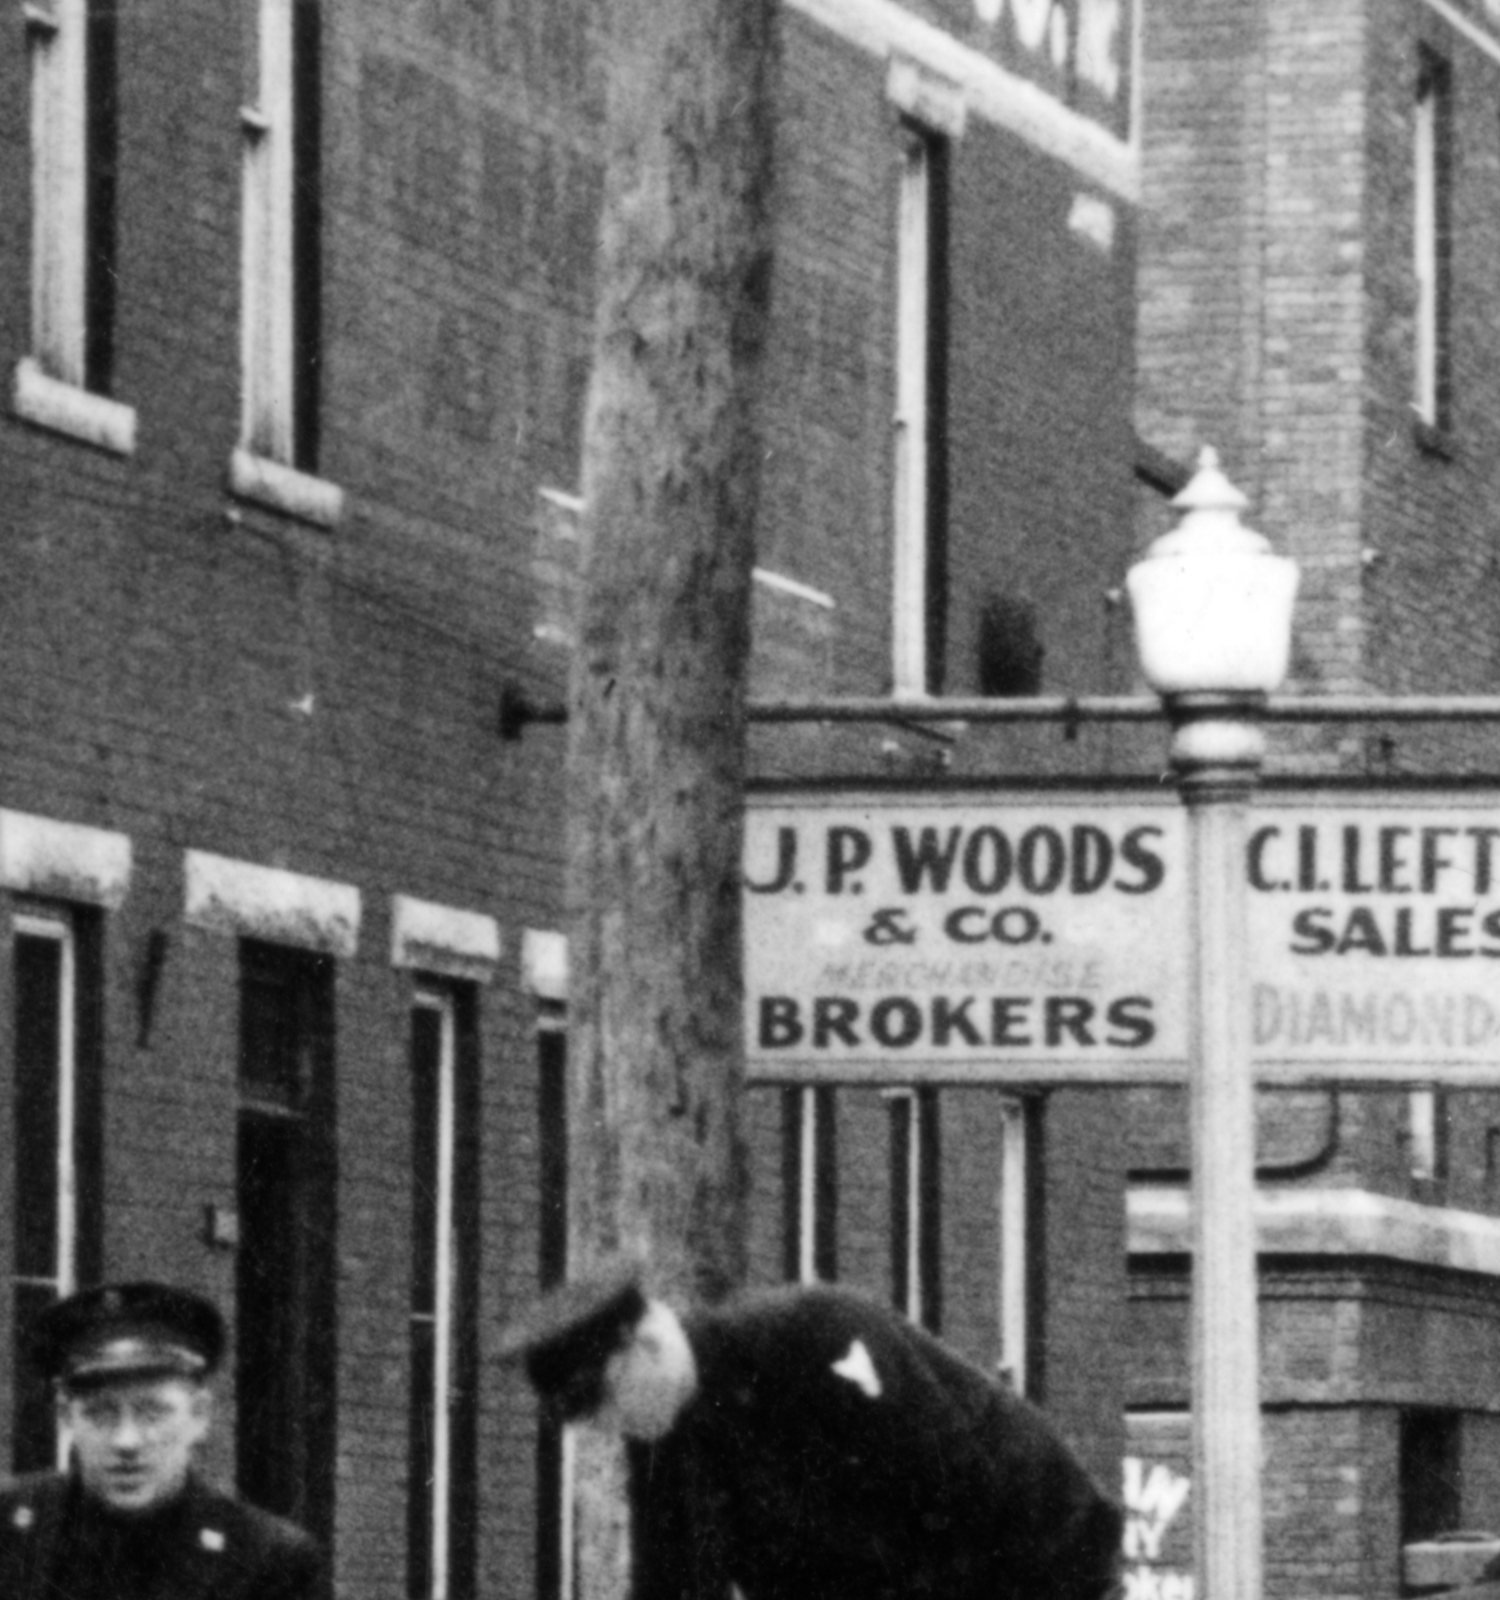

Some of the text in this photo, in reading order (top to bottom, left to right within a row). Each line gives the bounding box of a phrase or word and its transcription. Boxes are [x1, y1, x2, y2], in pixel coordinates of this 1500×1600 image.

[890, 824, 1167, 896] WOODS
[862, 906, 1054, 947] & CO.
[758, 996, 1158, 1050] BROKERS
